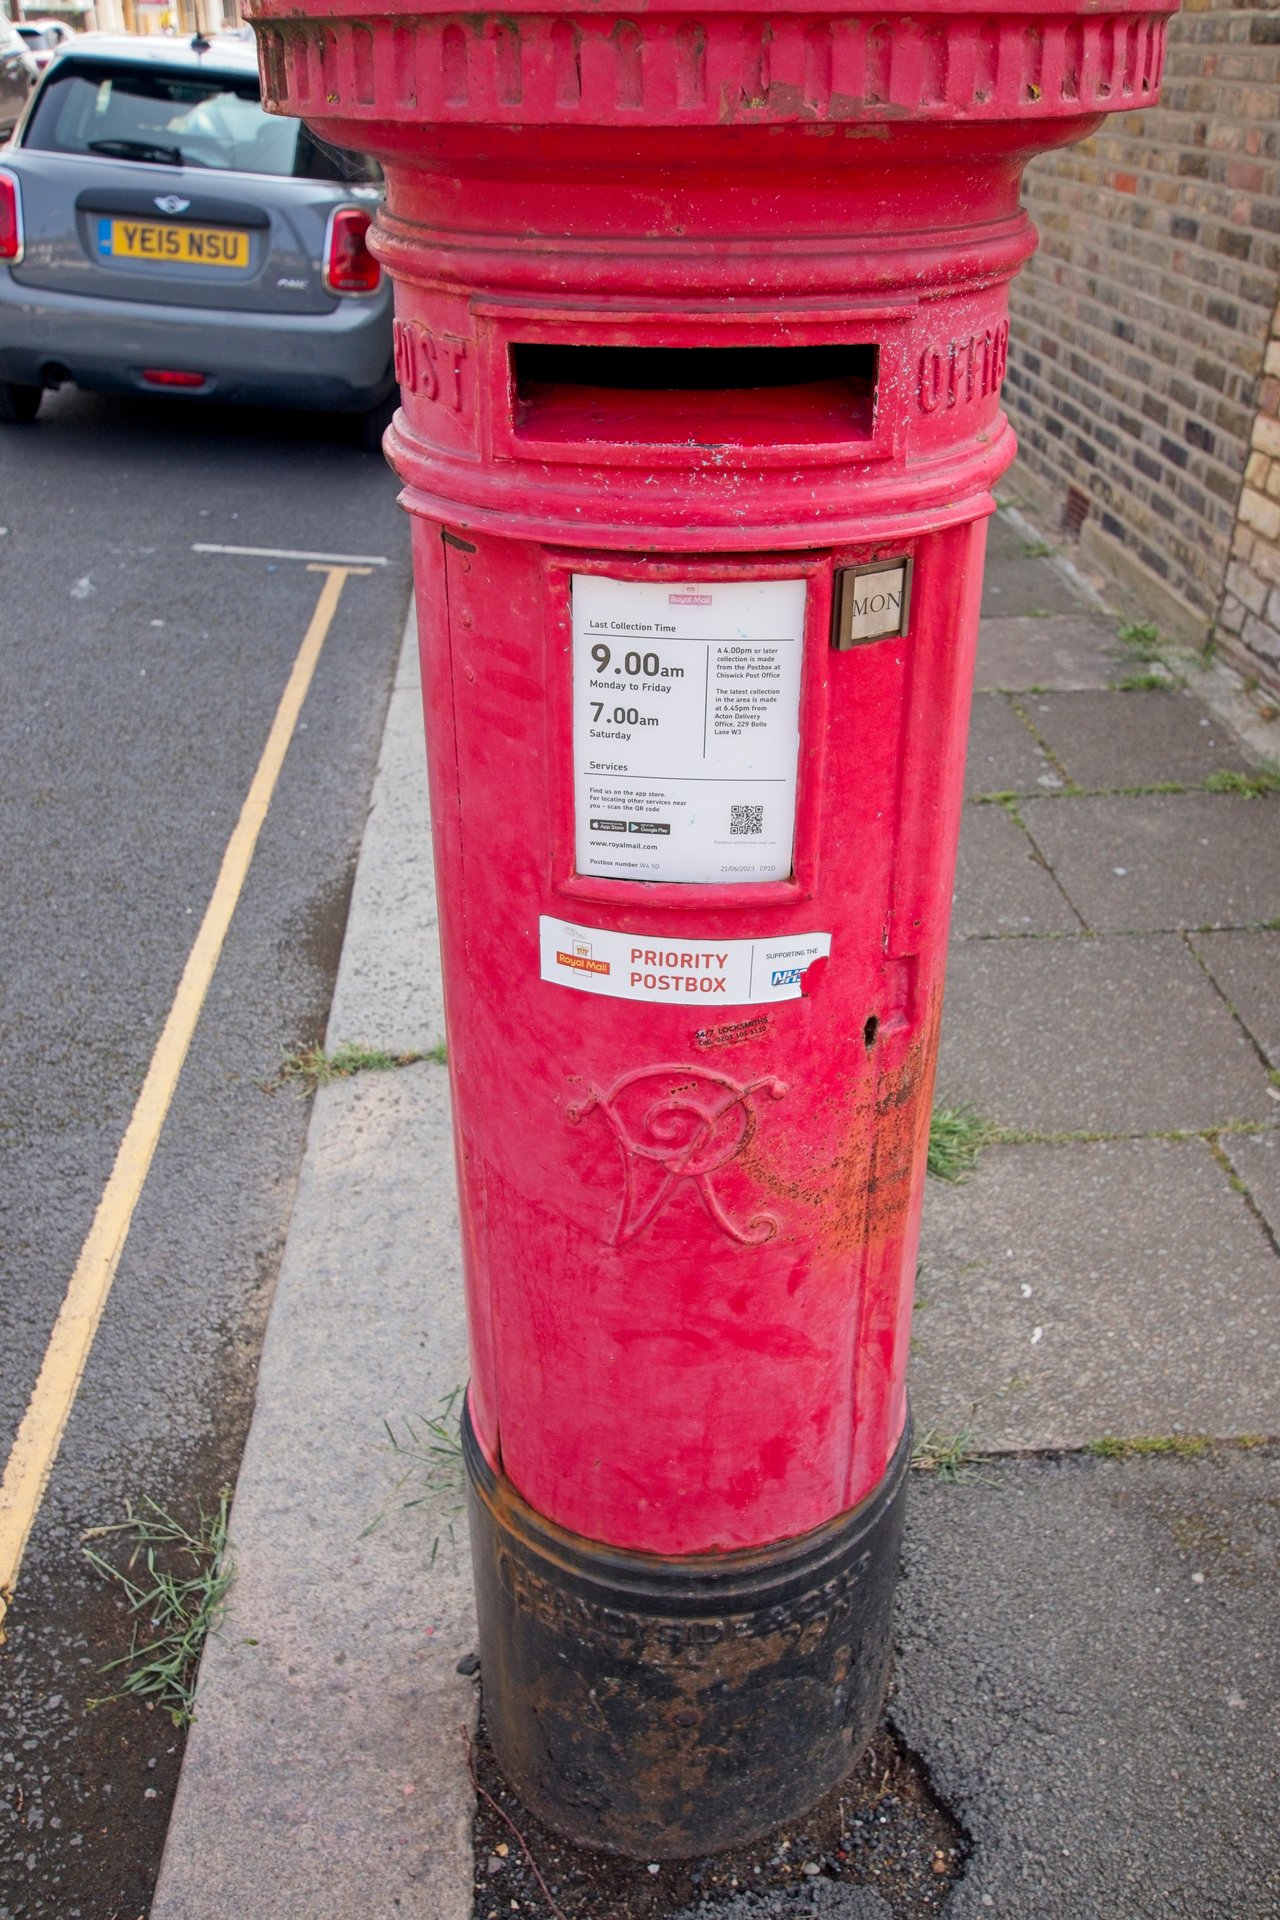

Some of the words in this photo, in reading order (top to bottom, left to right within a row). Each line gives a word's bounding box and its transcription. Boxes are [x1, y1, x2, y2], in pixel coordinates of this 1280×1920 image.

[123, 225, 181, 254] YE15
[187, 232, 239, 260] NSU
[917, 320, 1009, 413] OFFIC
[670, 595, 692, 604] Royal
[693, 596, 711, 604] Mail
[852, 590, 903, 617] MON
[589, 620, 608, 629] Last
[610, 621, 652, 631] Collection
[654, 624, 677, 632] Time
[723, 646, 752, 655] 4.00pm
[591, 643, 684, 678] 9.00am
[589, 679, 626, 692] Monday
[629, 683, 639, 691] to
[642, 682, 672, 694] Friday
[589, 701, 659, 726] 7.00am
[589, 729, 632, 741] Saturday
[589, 761, 628, 771] Services
[589, 840, 658, 850] www.royalmail.com
[589, 858, 613, 866] Postbox
[614, 860, 638, 868] number
[559, 953, 585, 967] Royal
[586, 960, 608, 972] Mail
[630, 948, 729, 969] PRIORITY
[765, 949, 806, 960] SUPPORTING
[630, 972, 726, 993] POSTBOX
[694, 1029, 714, 1039] 24/7
[717, 1016, 769, 1034] LOCKSMITHS
